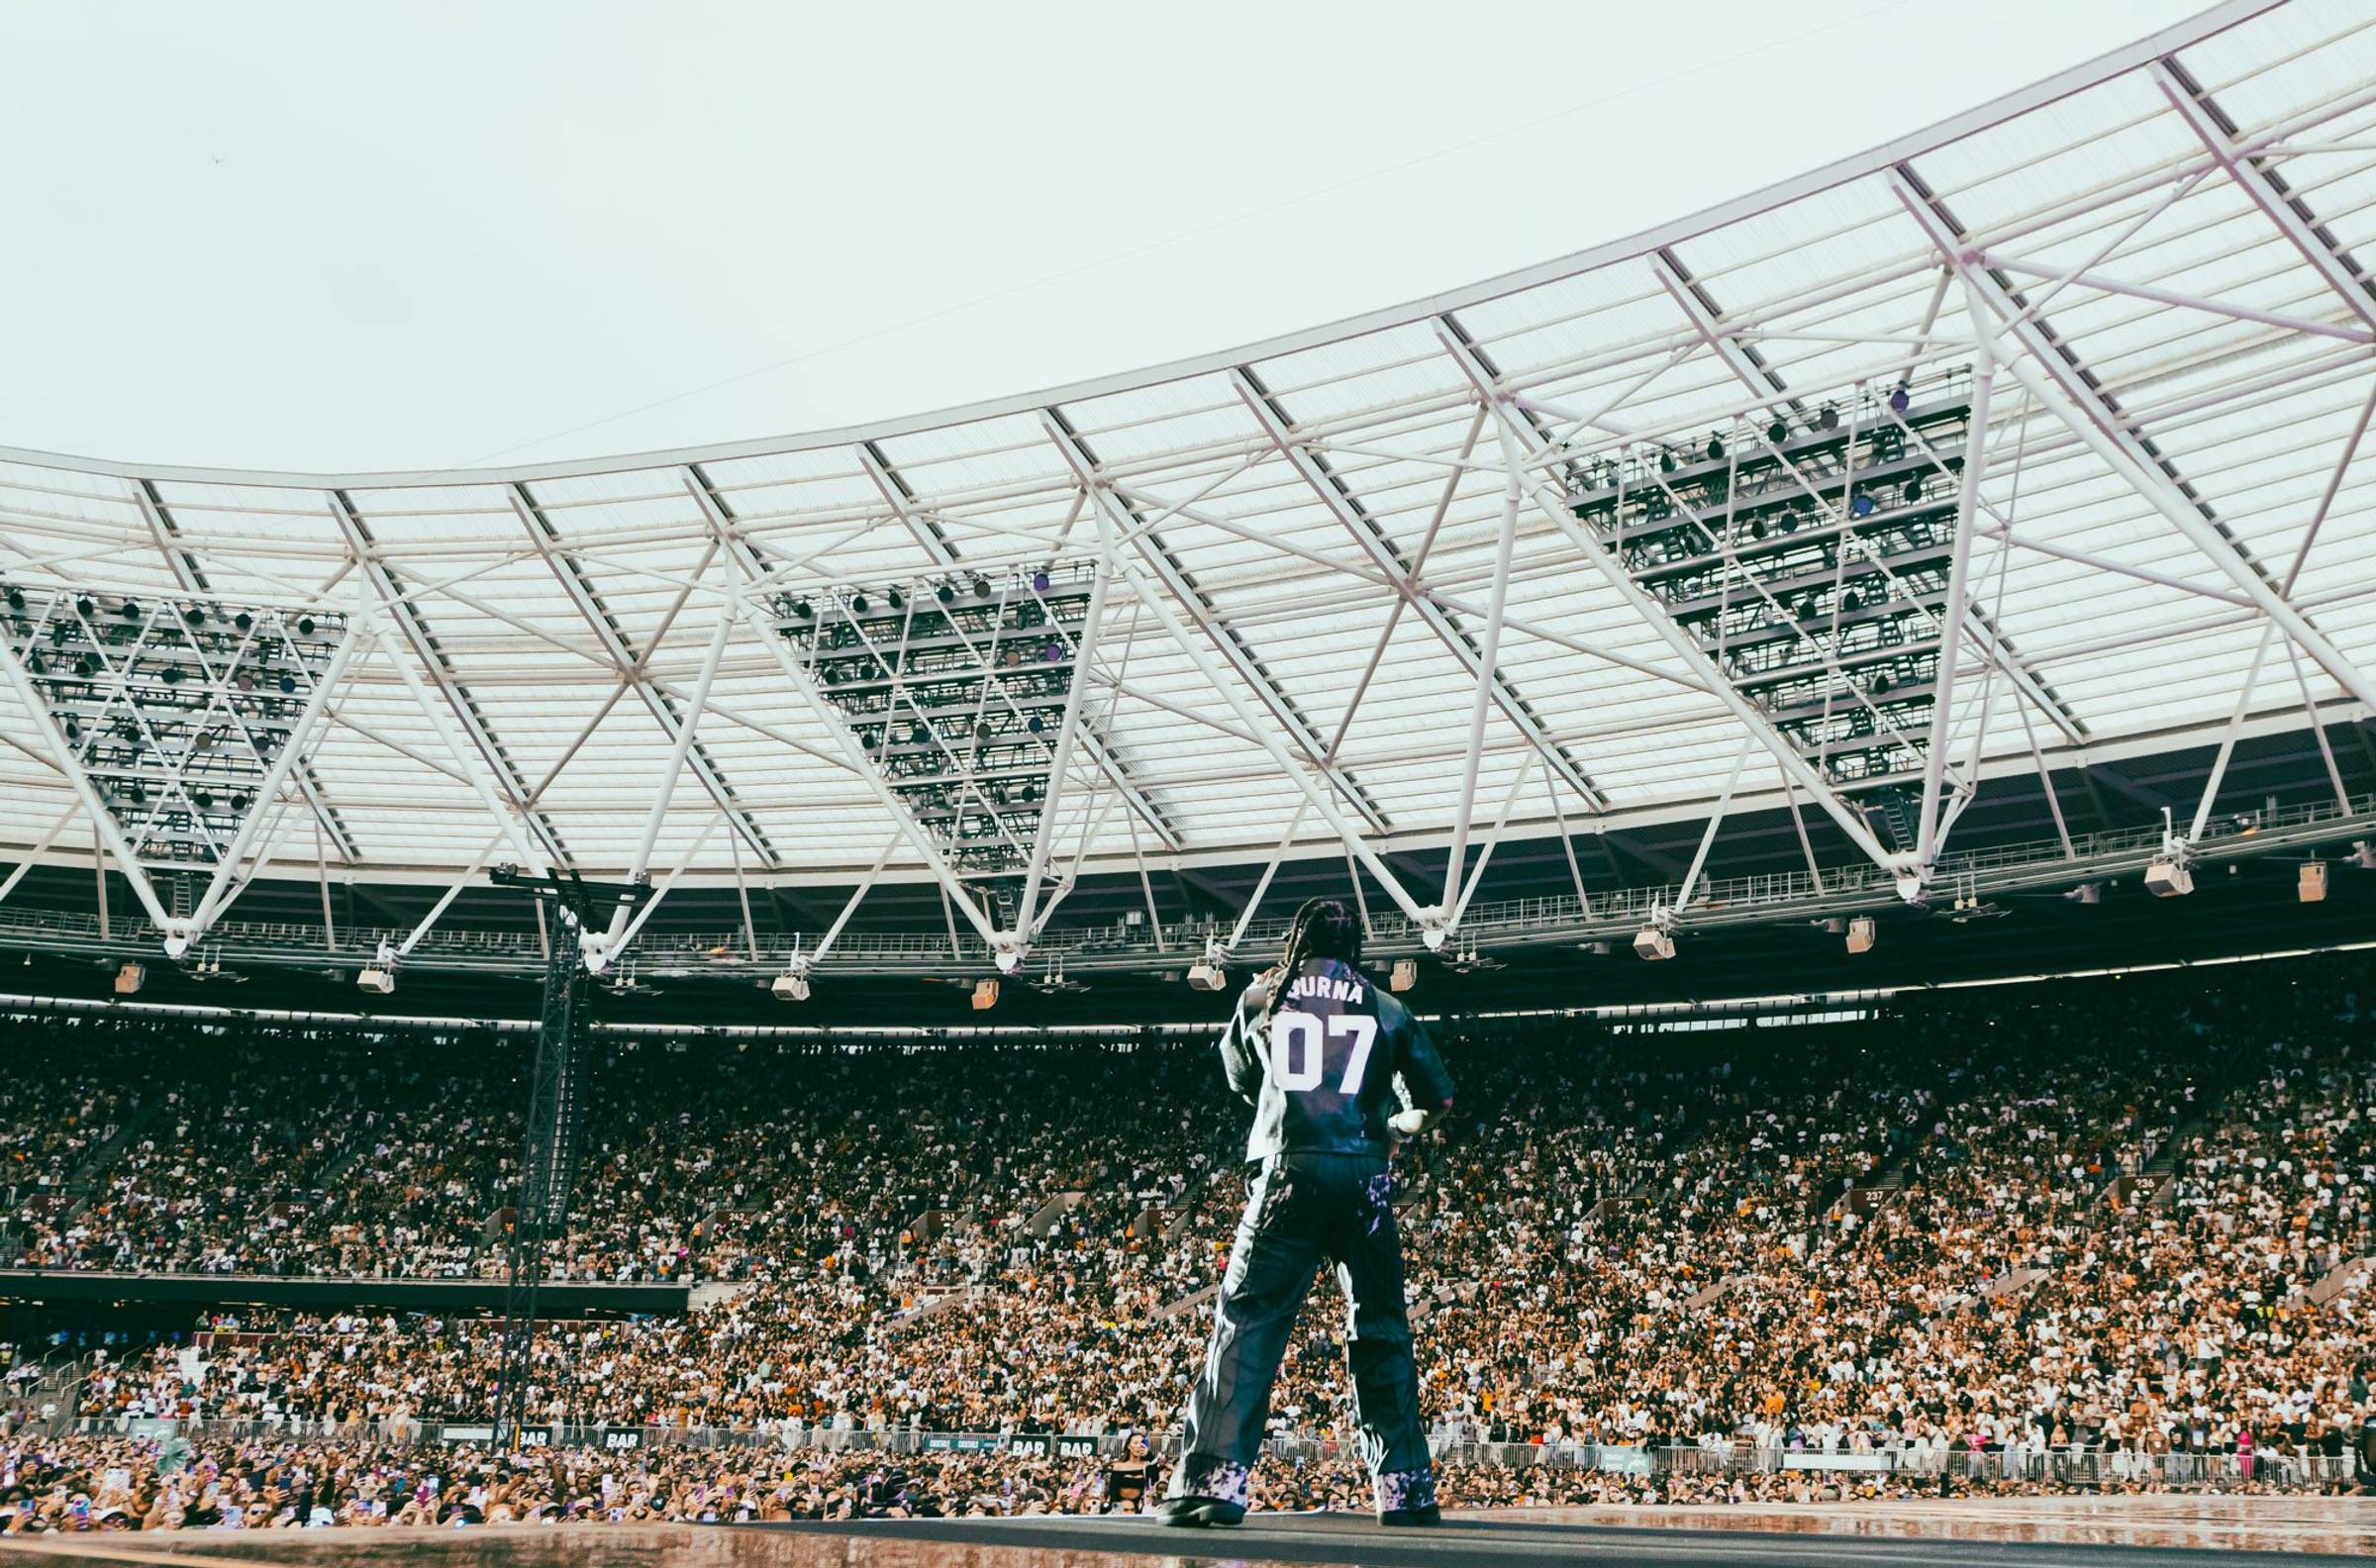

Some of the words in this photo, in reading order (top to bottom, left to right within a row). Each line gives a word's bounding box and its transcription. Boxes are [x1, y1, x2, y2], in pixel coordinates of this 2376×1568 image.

[1270, 1012, 1378, 1095] 07
[2134, 1178, 2155, 1188] 236
[1866, 1191, 1884, 1201] 237
[729, 1212, 745, 1222] 242
[940, 1213, 955, 1222] 241
[1160, 1211, 1176, 1220] 240
[606, 1432, 639, 1448] BAR
[1012, 1440, 1045, 1458] BAR
